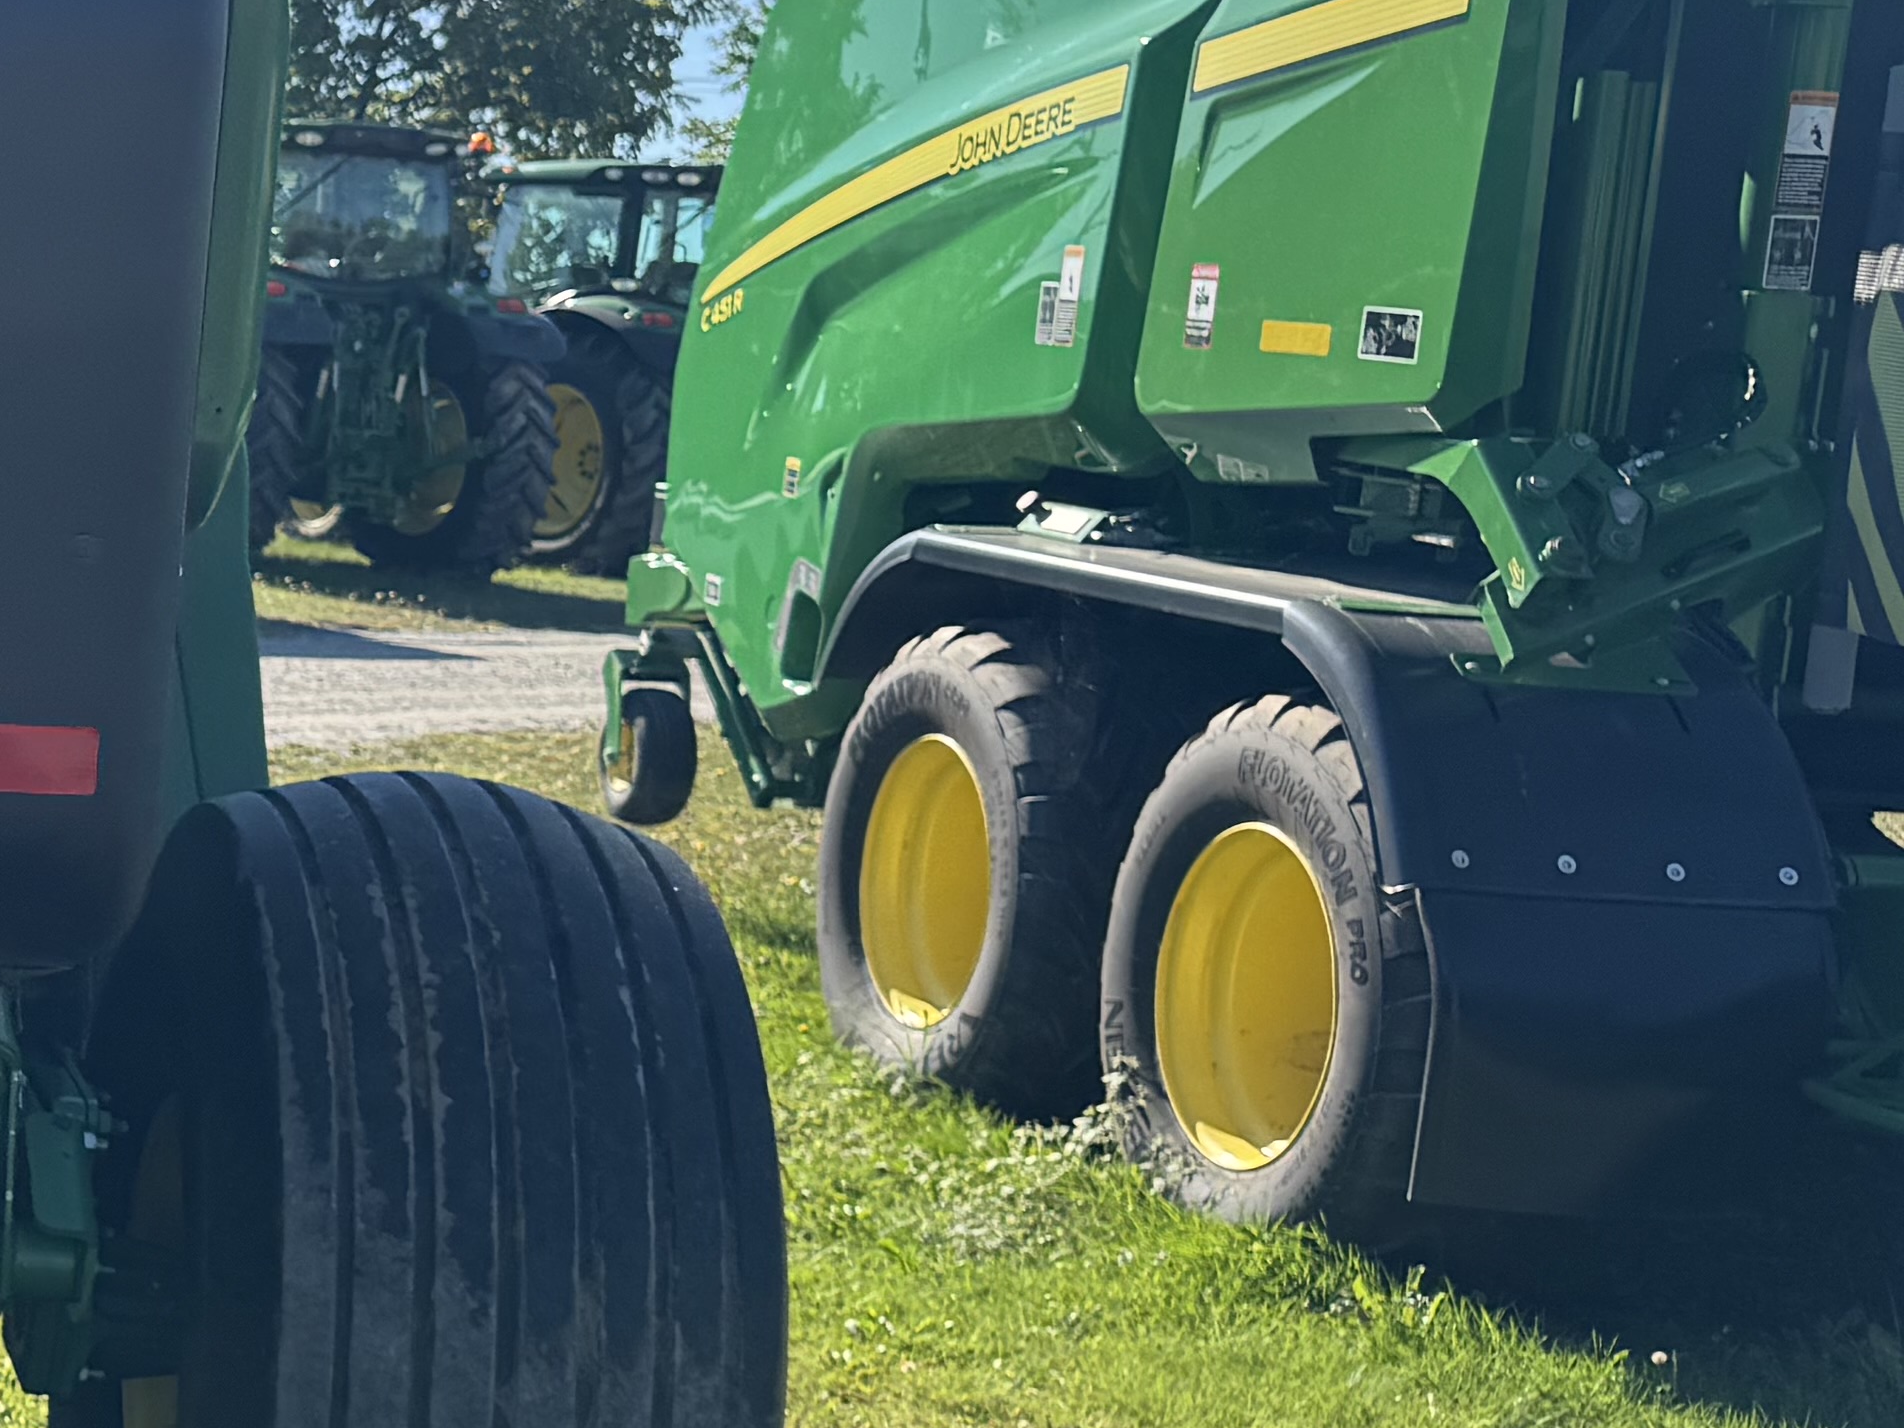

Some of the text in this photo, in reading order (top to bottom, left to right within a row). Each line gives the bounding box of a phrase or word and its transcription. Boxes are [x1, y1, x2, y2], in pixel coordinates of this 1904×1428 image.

[947, 96, 1076, 170] JOHN DEERE
[1237, 745, 1370, 988] FLOTATION PRO
